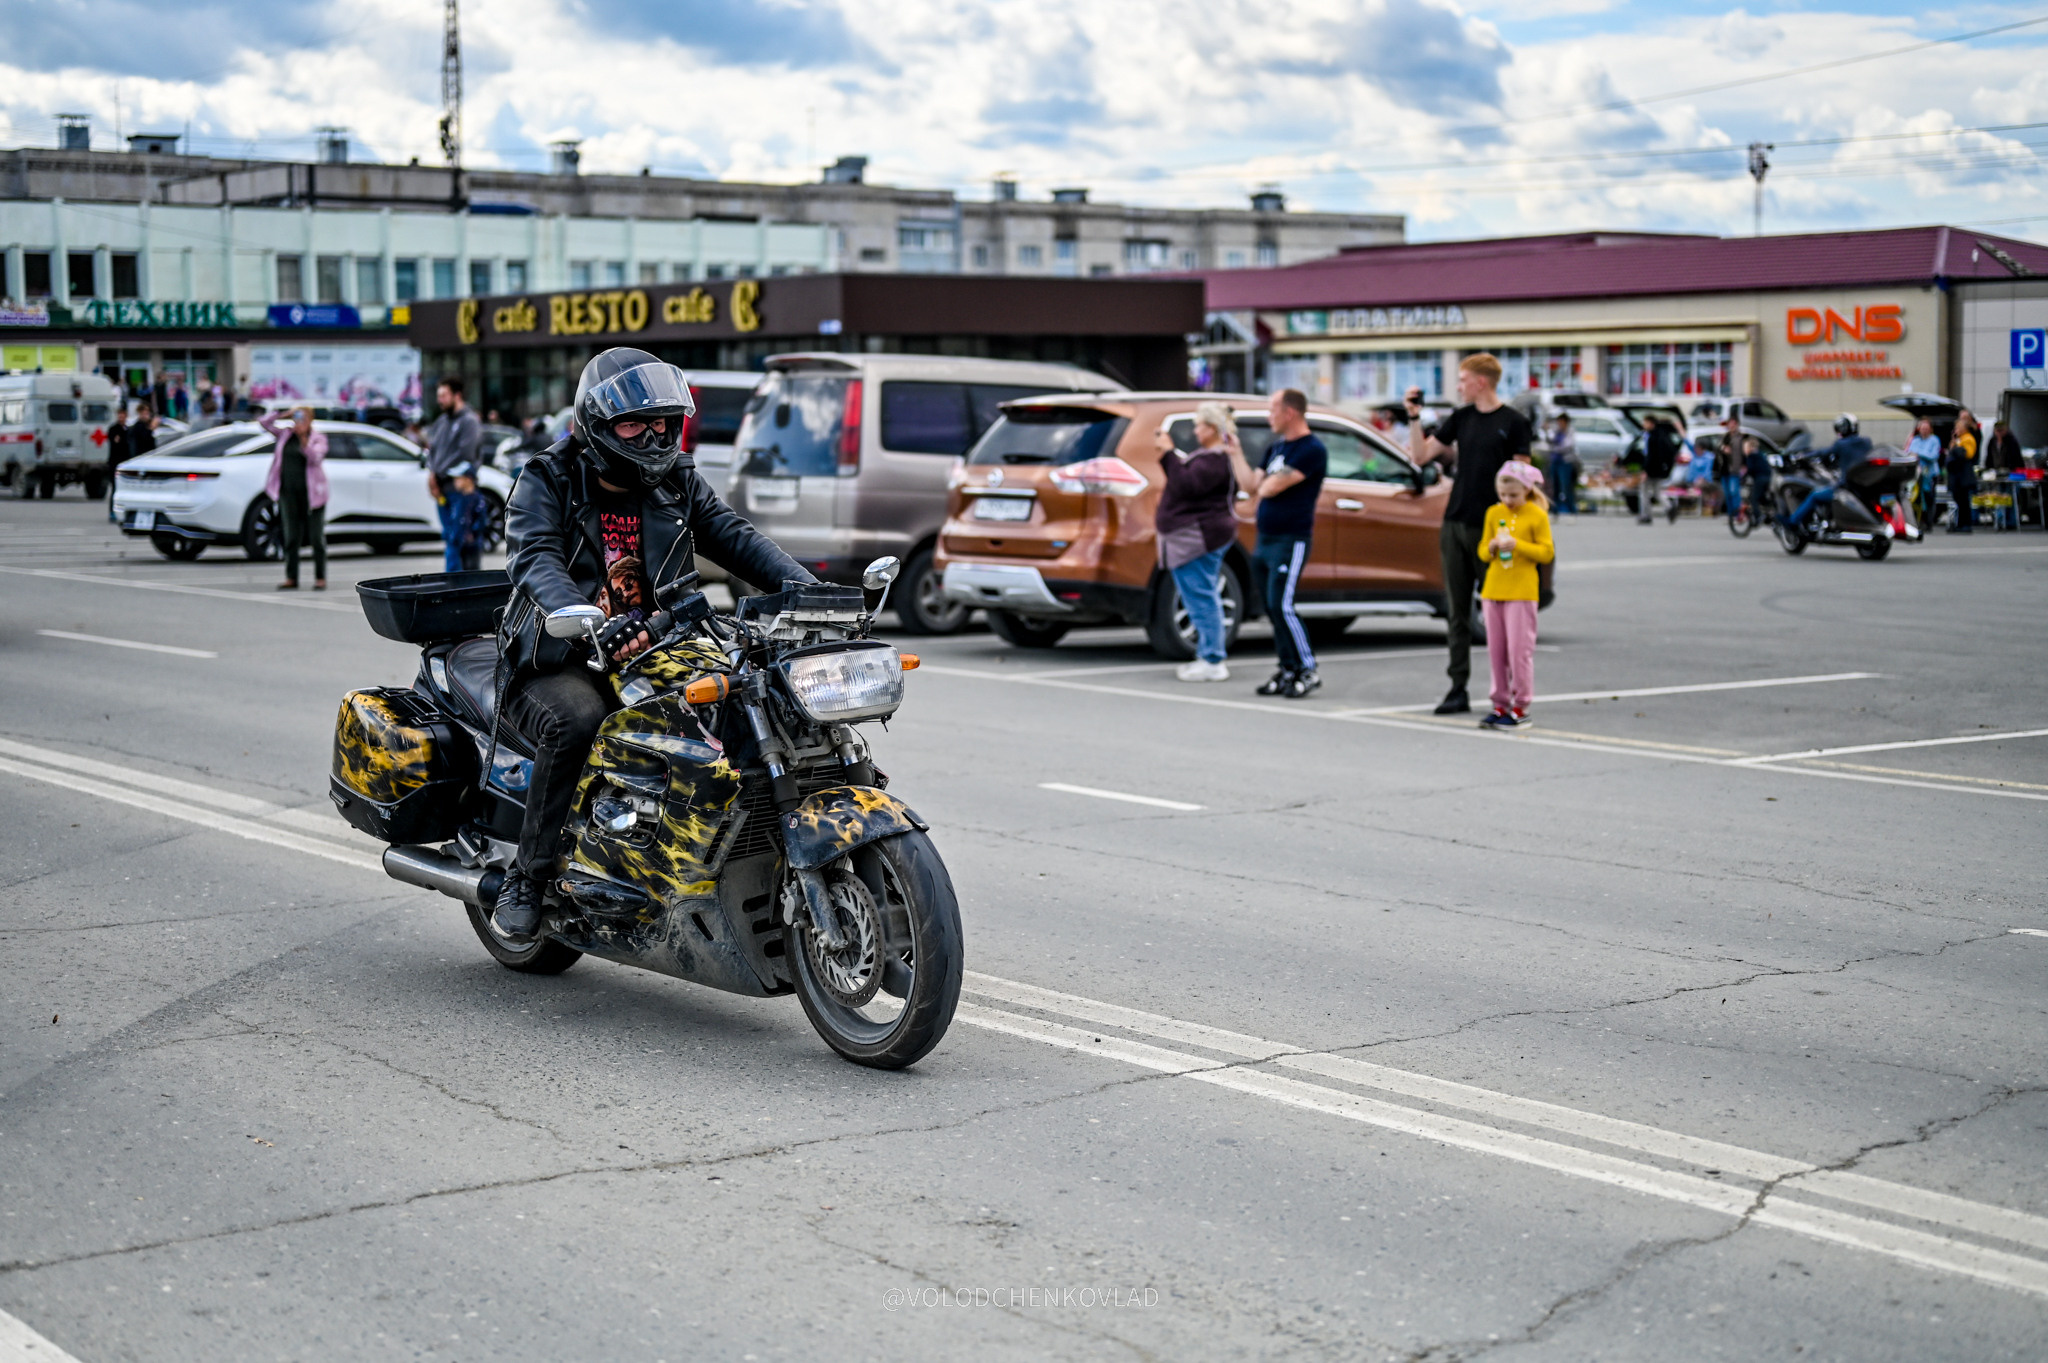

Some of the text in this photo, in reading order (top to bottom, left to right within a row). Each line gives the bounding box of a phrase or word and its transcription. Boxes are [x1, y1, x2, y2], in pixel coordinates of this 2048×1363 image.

[86, 299, 238, 327] ТЕХНИК
[550, 289, 649, 336] RESTO
[1333, 304, 1467, 328] ПЛАТИНА
[1787, 304, 1903, 344] DNS
